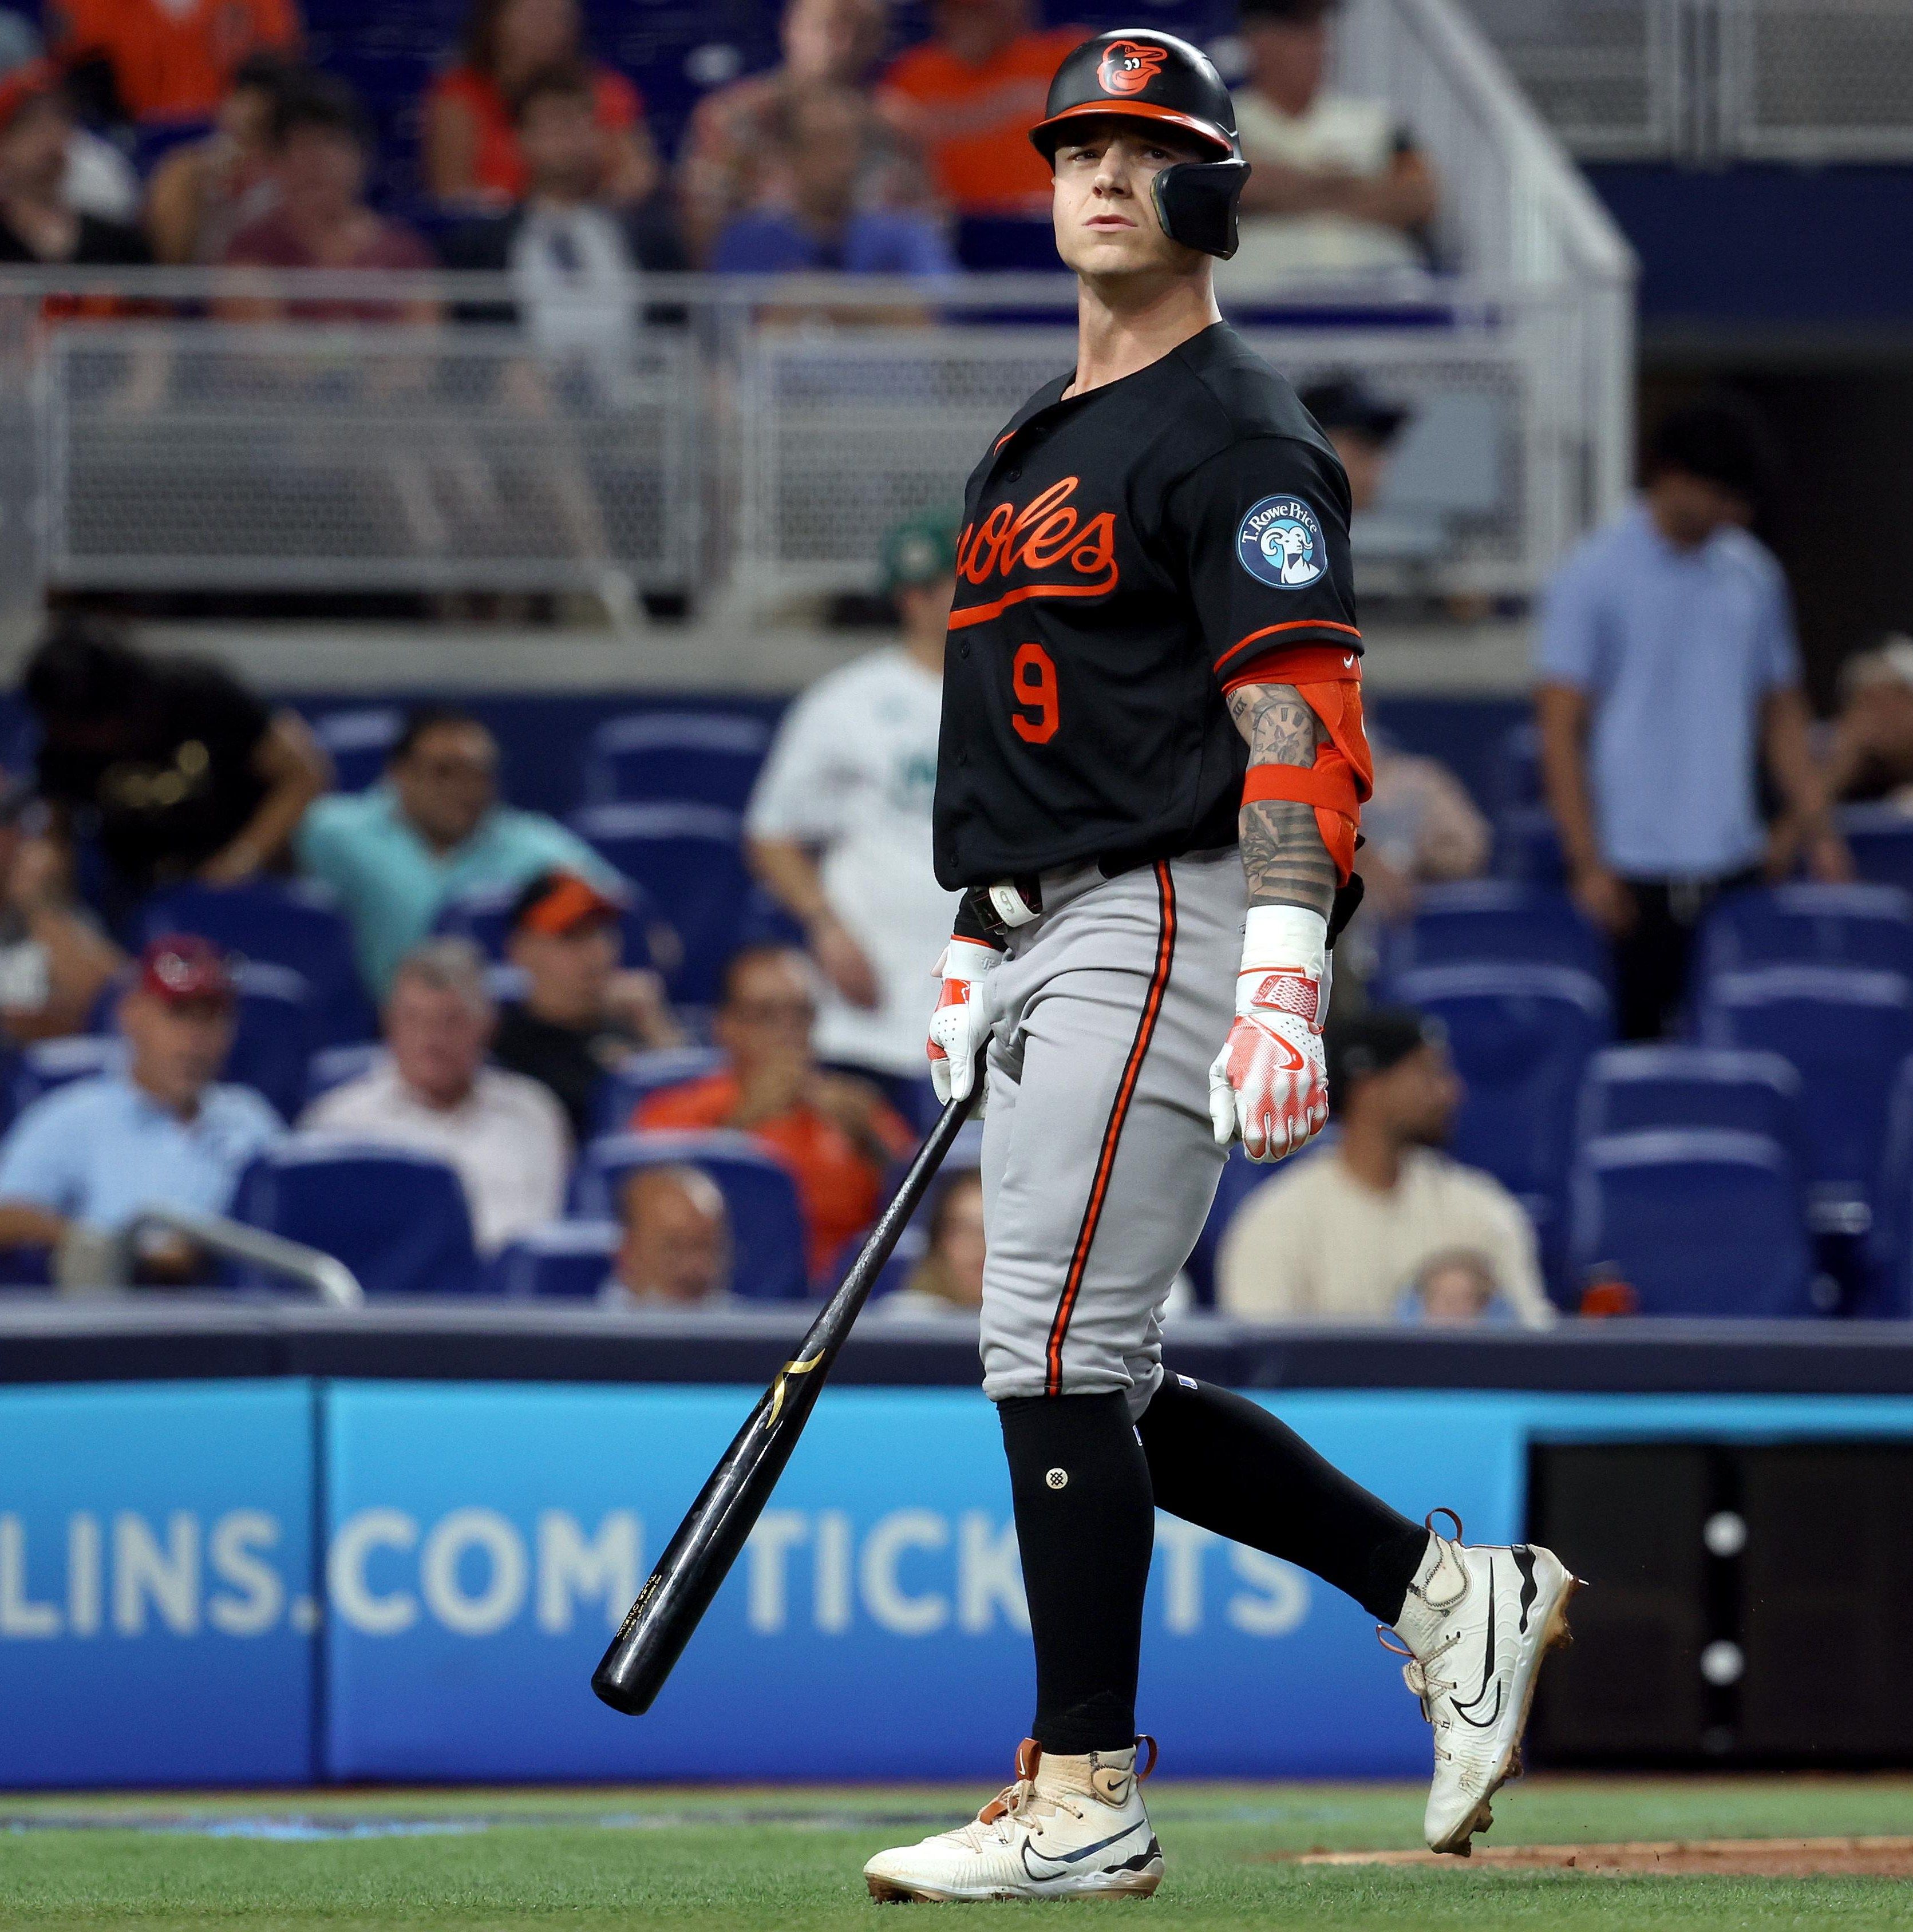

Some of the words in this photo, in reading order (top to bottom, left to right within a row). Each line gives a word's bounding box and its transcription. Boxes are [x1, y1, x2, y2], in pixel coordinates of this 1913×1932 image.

[1248, 505, 1288, 532] Rowe
[1288, 502, 1317, 533] Price
[1013, 643, 1059, 744] 9
[747, 1509, 1313, 1637] TICKTS
